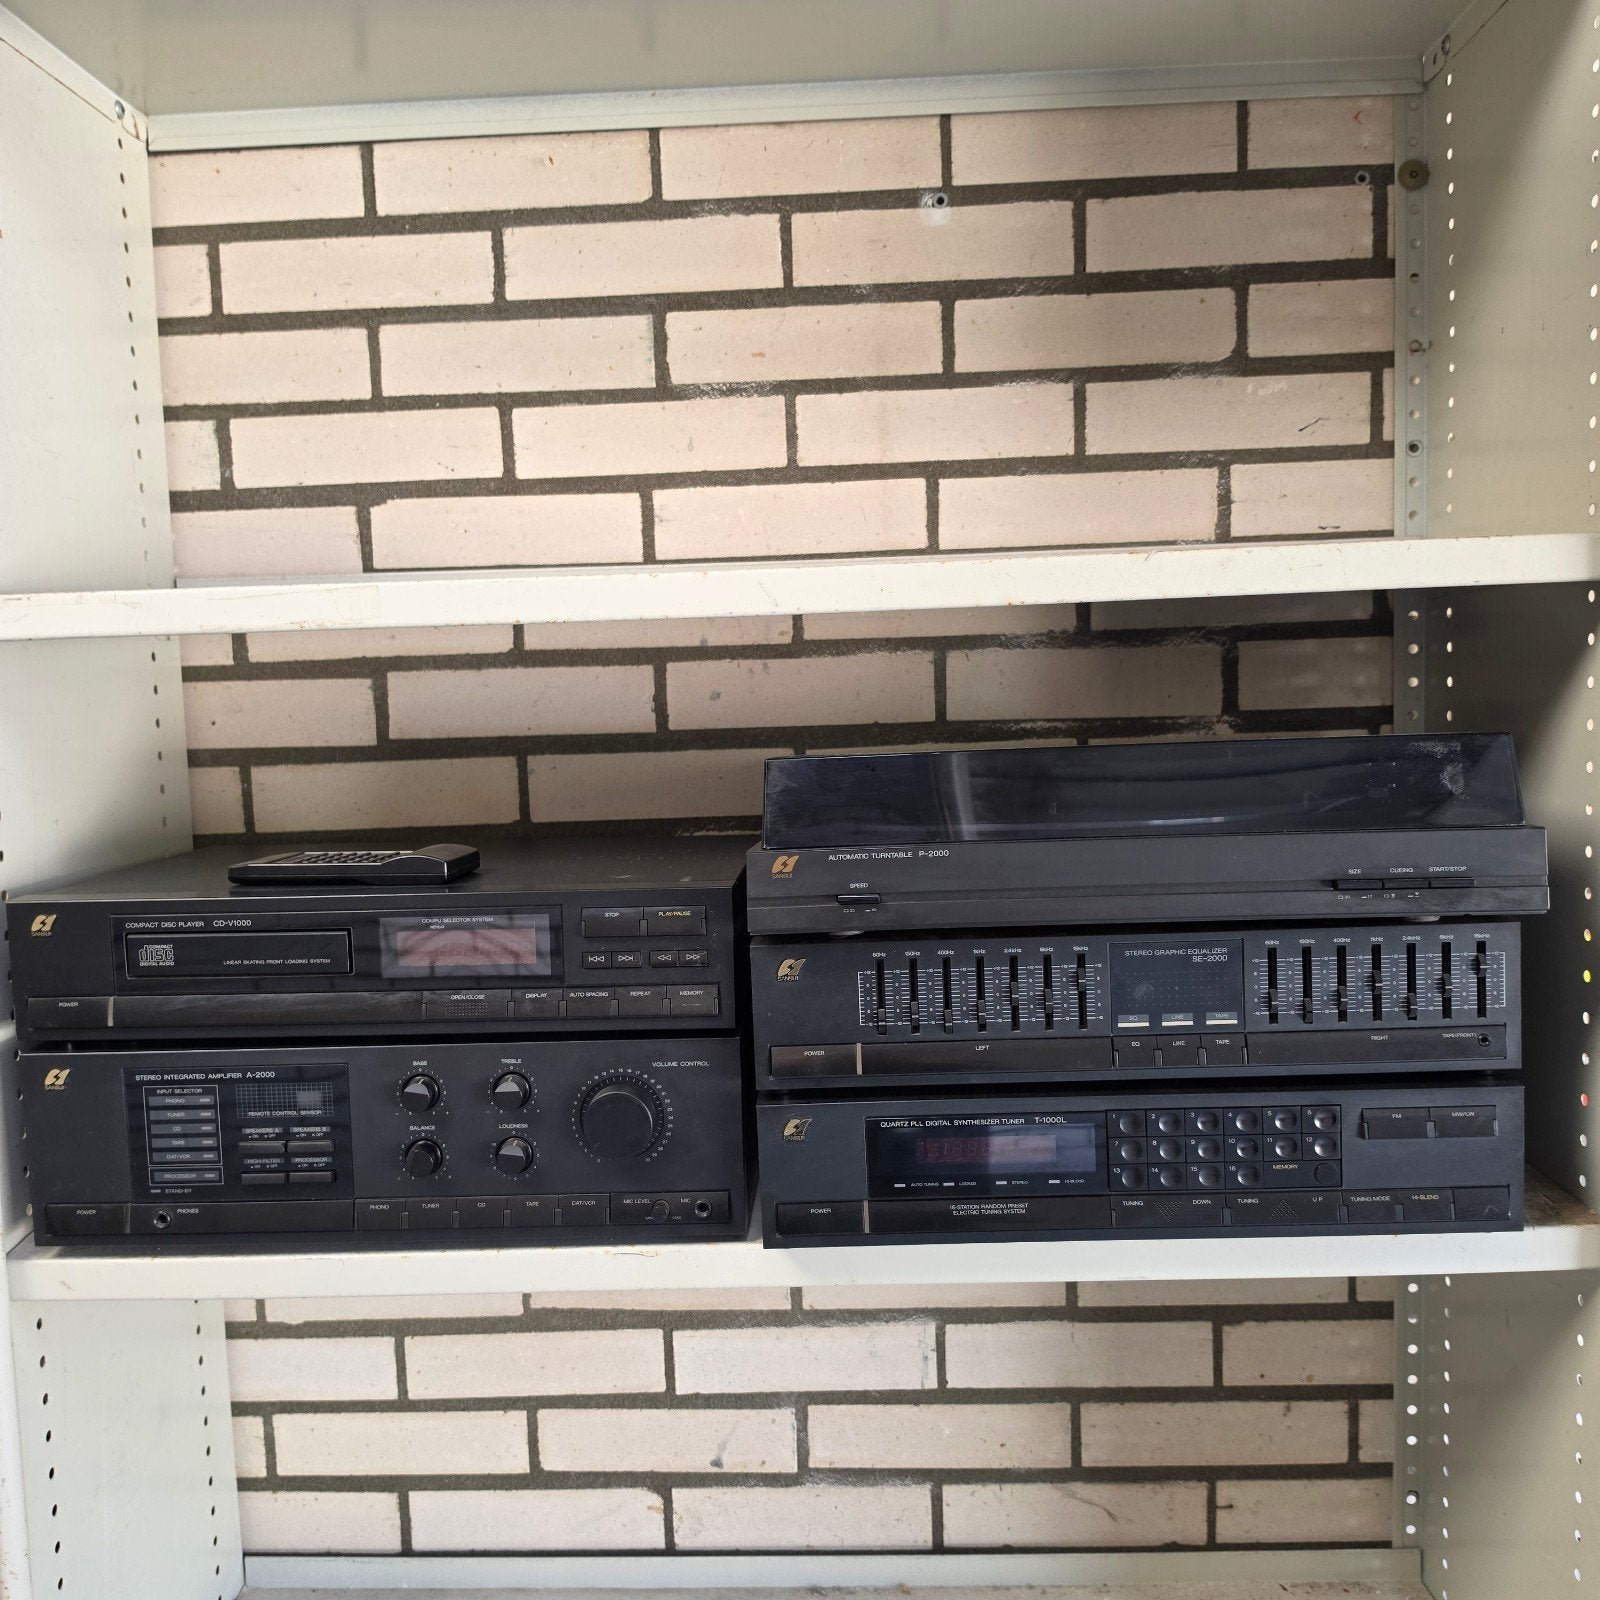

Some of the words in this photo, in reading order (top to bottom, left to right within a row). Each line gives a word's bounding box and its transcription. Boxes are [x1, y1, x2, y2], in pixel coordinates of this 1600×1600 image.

[828, 852, 869, 861] AUTOMATIC
[870, 851, 913, 860] TURNTABLE
[918, 849, 950, 858] P-2000
[1428, 865, 1467, 873] START/STOP
[771, 872, 793, 880] SANSUI
[161, 921, 177, 929] DISC
[213, 919, 252, 927] CD-V1000
[1124, 949, 1153, 957] STEREO
[1154, 948, 1187, 956] GRAPHIC
[1187, 947, 1228, 955] EQUALIZER
[1192, 955, 1228, 963] SE-2000
[163, 1073, 206, 1081] INTEGRATED
[207, 1072, 243, 1080] AMPLIFIER
[246, 1071, 276, 1079] A-2000
[880, 1120, 909, 1128] QUARTZ
[925, 1119, 952, 1127] DIGITAL
[953, 1118, 1000, 1126] SYNTHESIZER
[1034, 1116, 1067, 1124] T-1000L
